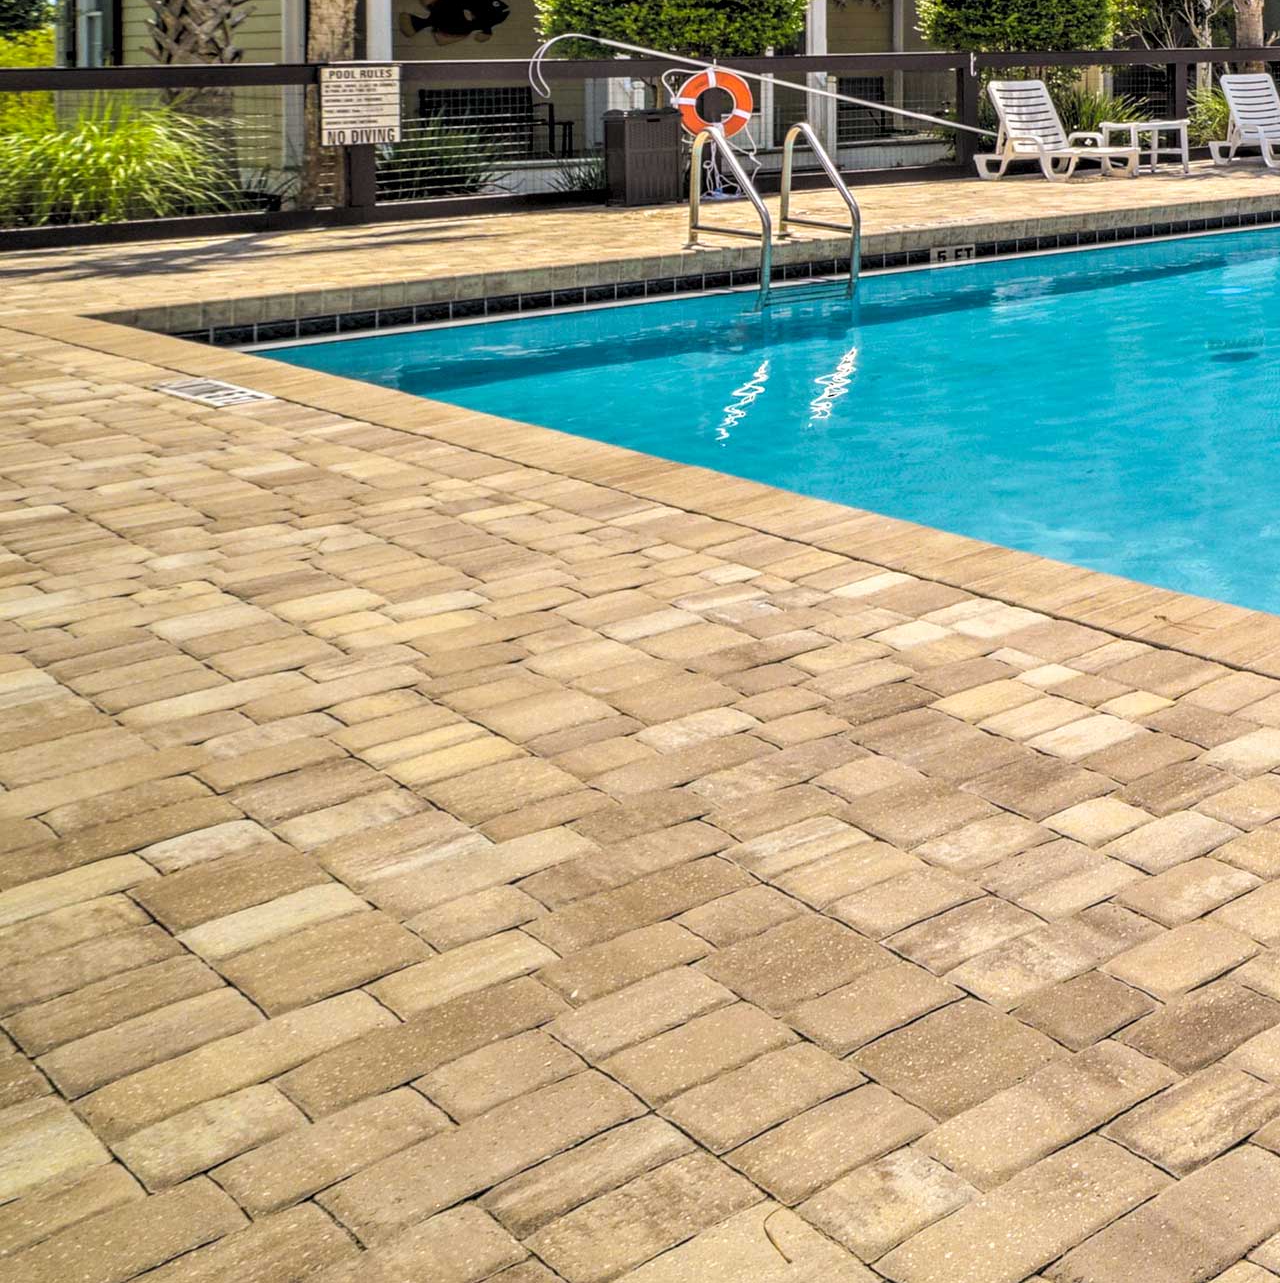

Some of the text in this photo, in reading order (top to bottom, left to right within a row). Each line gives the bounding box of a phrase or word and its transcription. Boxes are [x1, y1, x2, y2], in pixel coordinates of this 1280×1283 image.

[328, 69, 392, 79] POOL RULES
[327, 128, 395, 144] NO DIVING
[955, 247, 973, 260] FT
